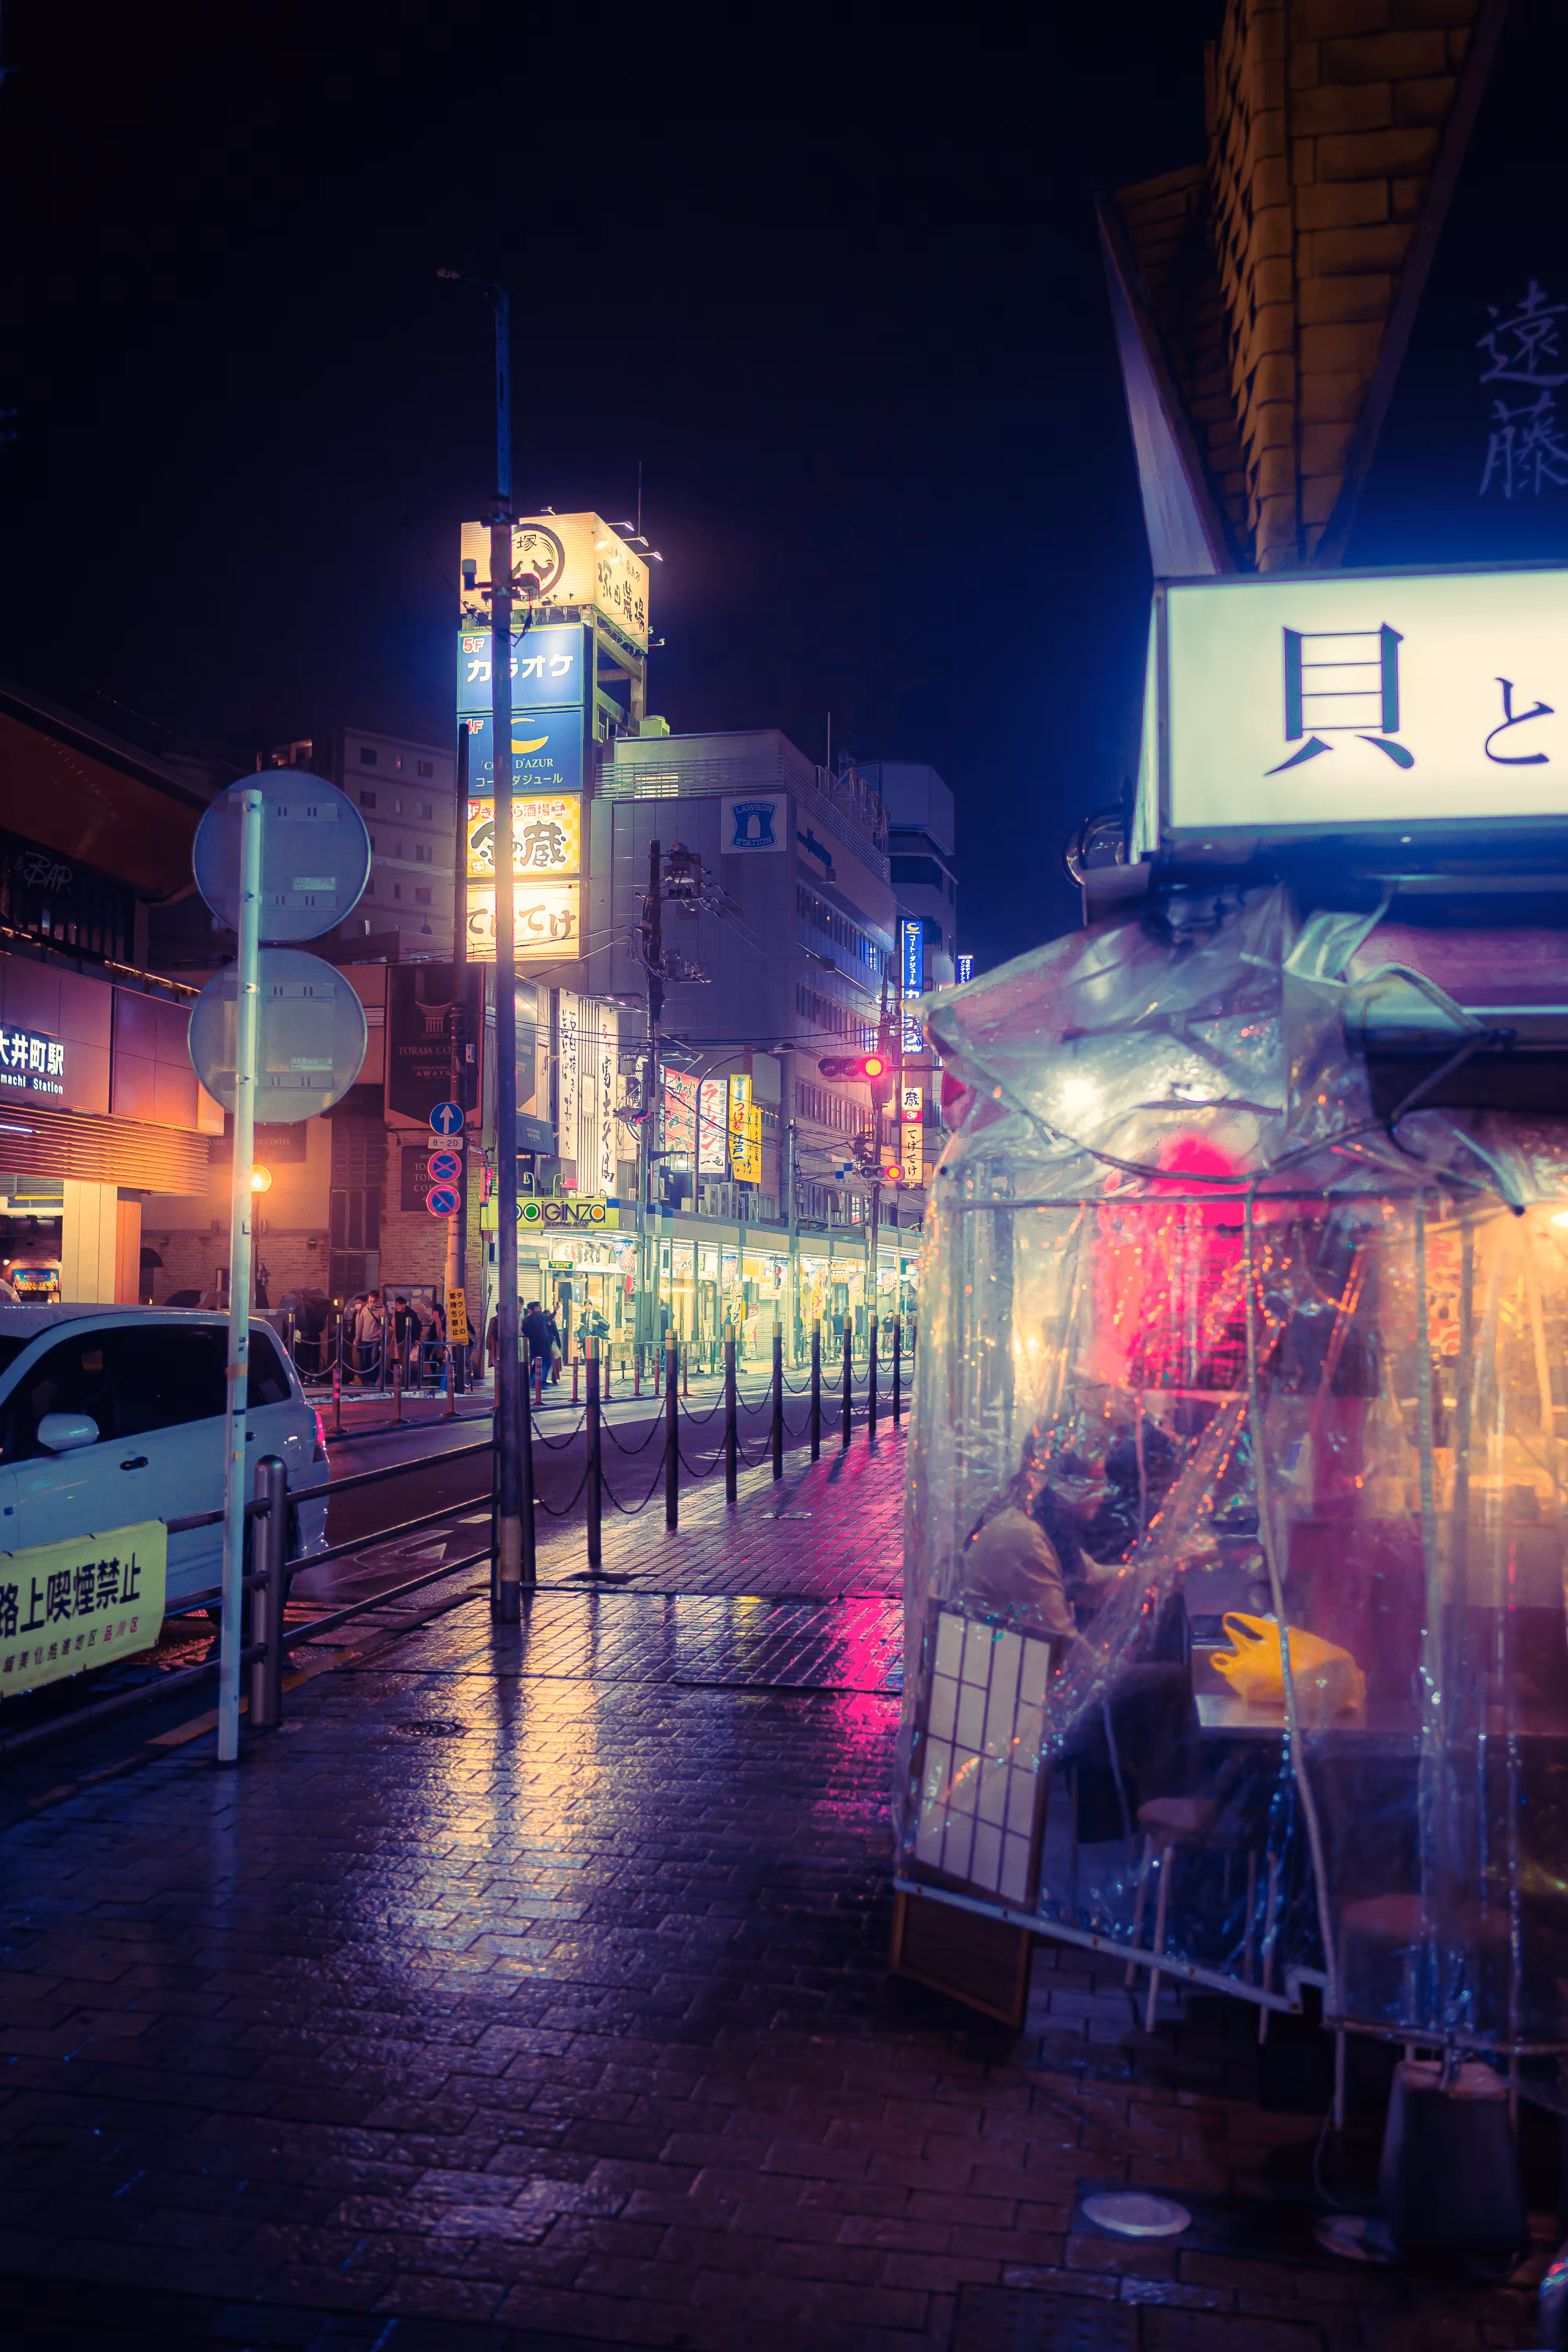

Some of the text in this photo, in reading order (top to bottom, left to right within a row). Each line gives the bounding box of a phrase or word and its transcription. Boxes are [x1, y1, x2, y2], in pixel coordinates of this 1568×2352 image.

[462, 637, 485, 654] 5F
[1263, 622, 1555, 778] 貝と
[476, 773, 563, 787] コーダジュール
[736, 804, 773, 814] LAWSON
[735, 837, 772, 846] STATION
[466, 904, 575, 938] ててけ
[33, 1078, 64, 1095] Station
[701, 1083, 719, 1151] ラーメン
[907, 1111, 918, 1120] 3F
[456, 1292, 466, 1334] タクシーの
[0, 1552, 141, 1639] 路上喫煙禁止
